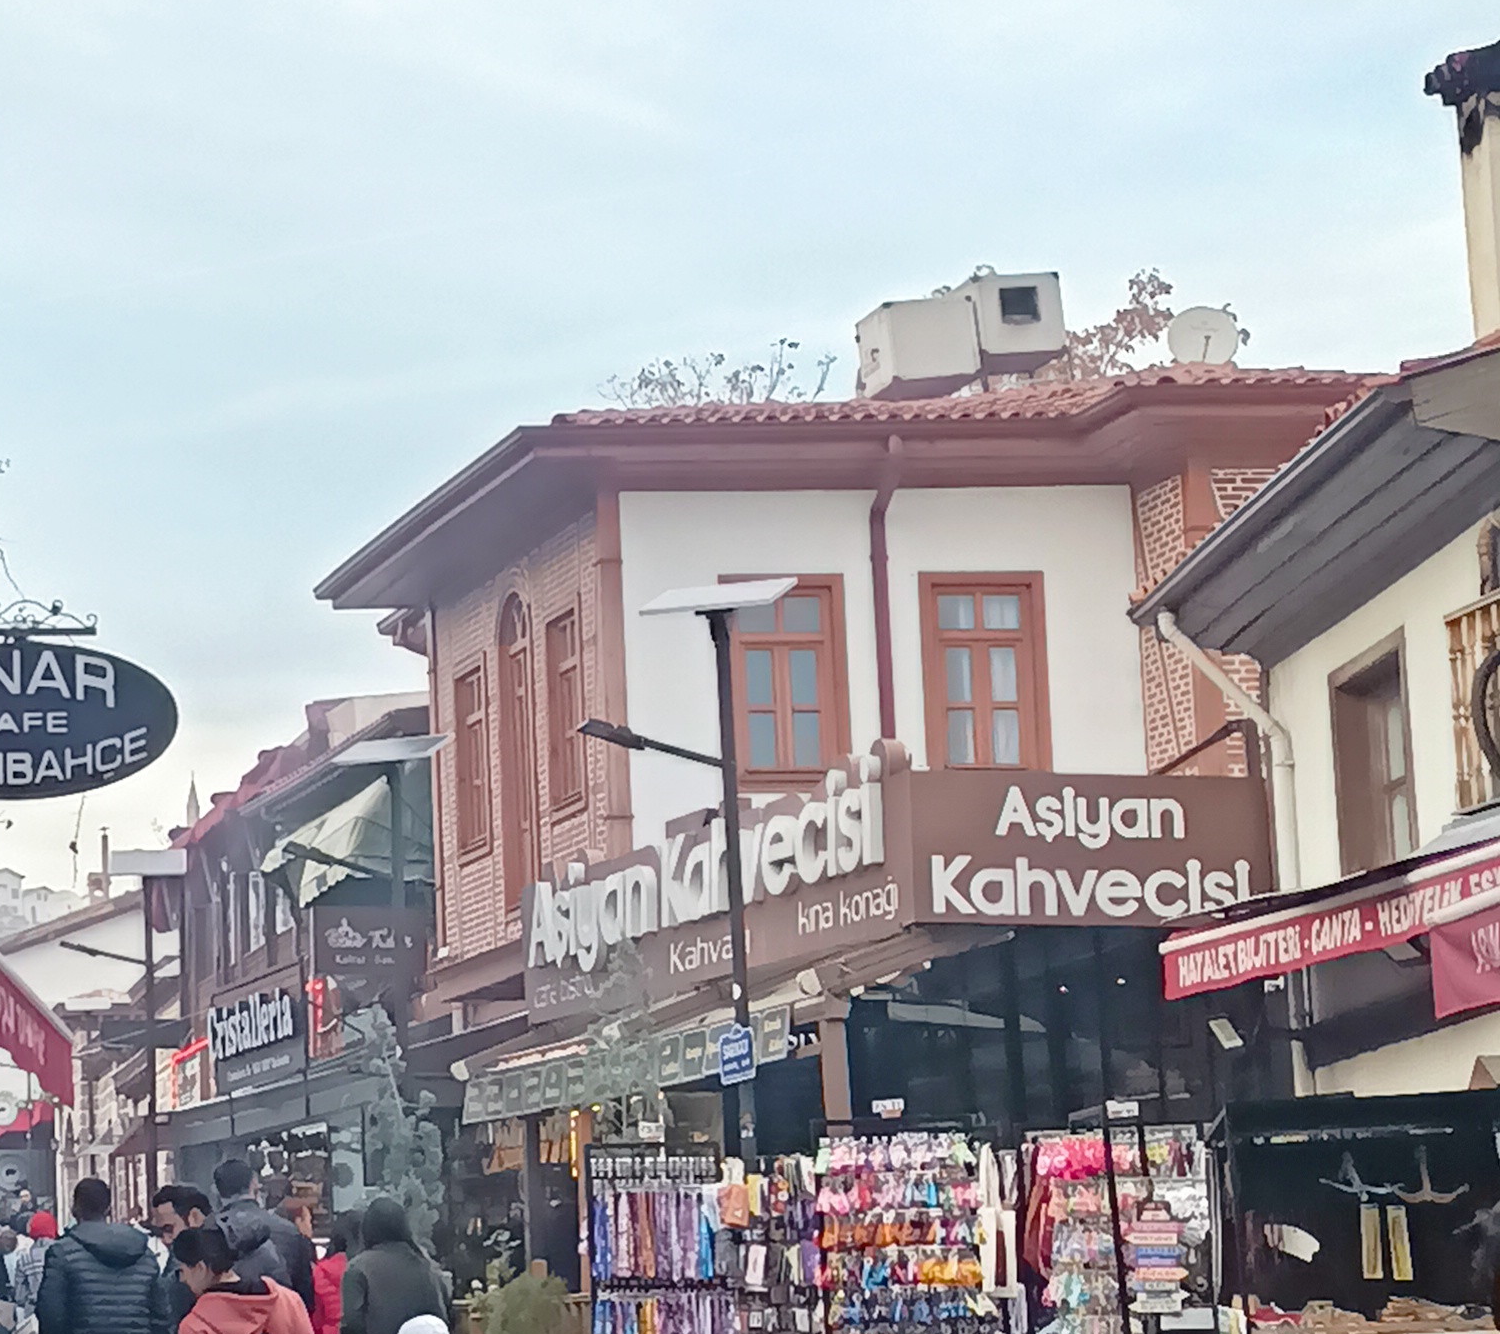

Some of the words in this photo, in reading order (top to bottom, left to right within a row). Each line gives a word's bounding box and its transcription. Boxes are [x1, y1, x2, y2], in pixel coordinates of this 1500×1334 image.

[995, 785, 1186, 849] Aşiyan
[931, 854, 1251, 919] Kahvecisi
[1178, 943, 1238, 988] HAYALET
[208, 987, 294, 1060] Cristalleria
